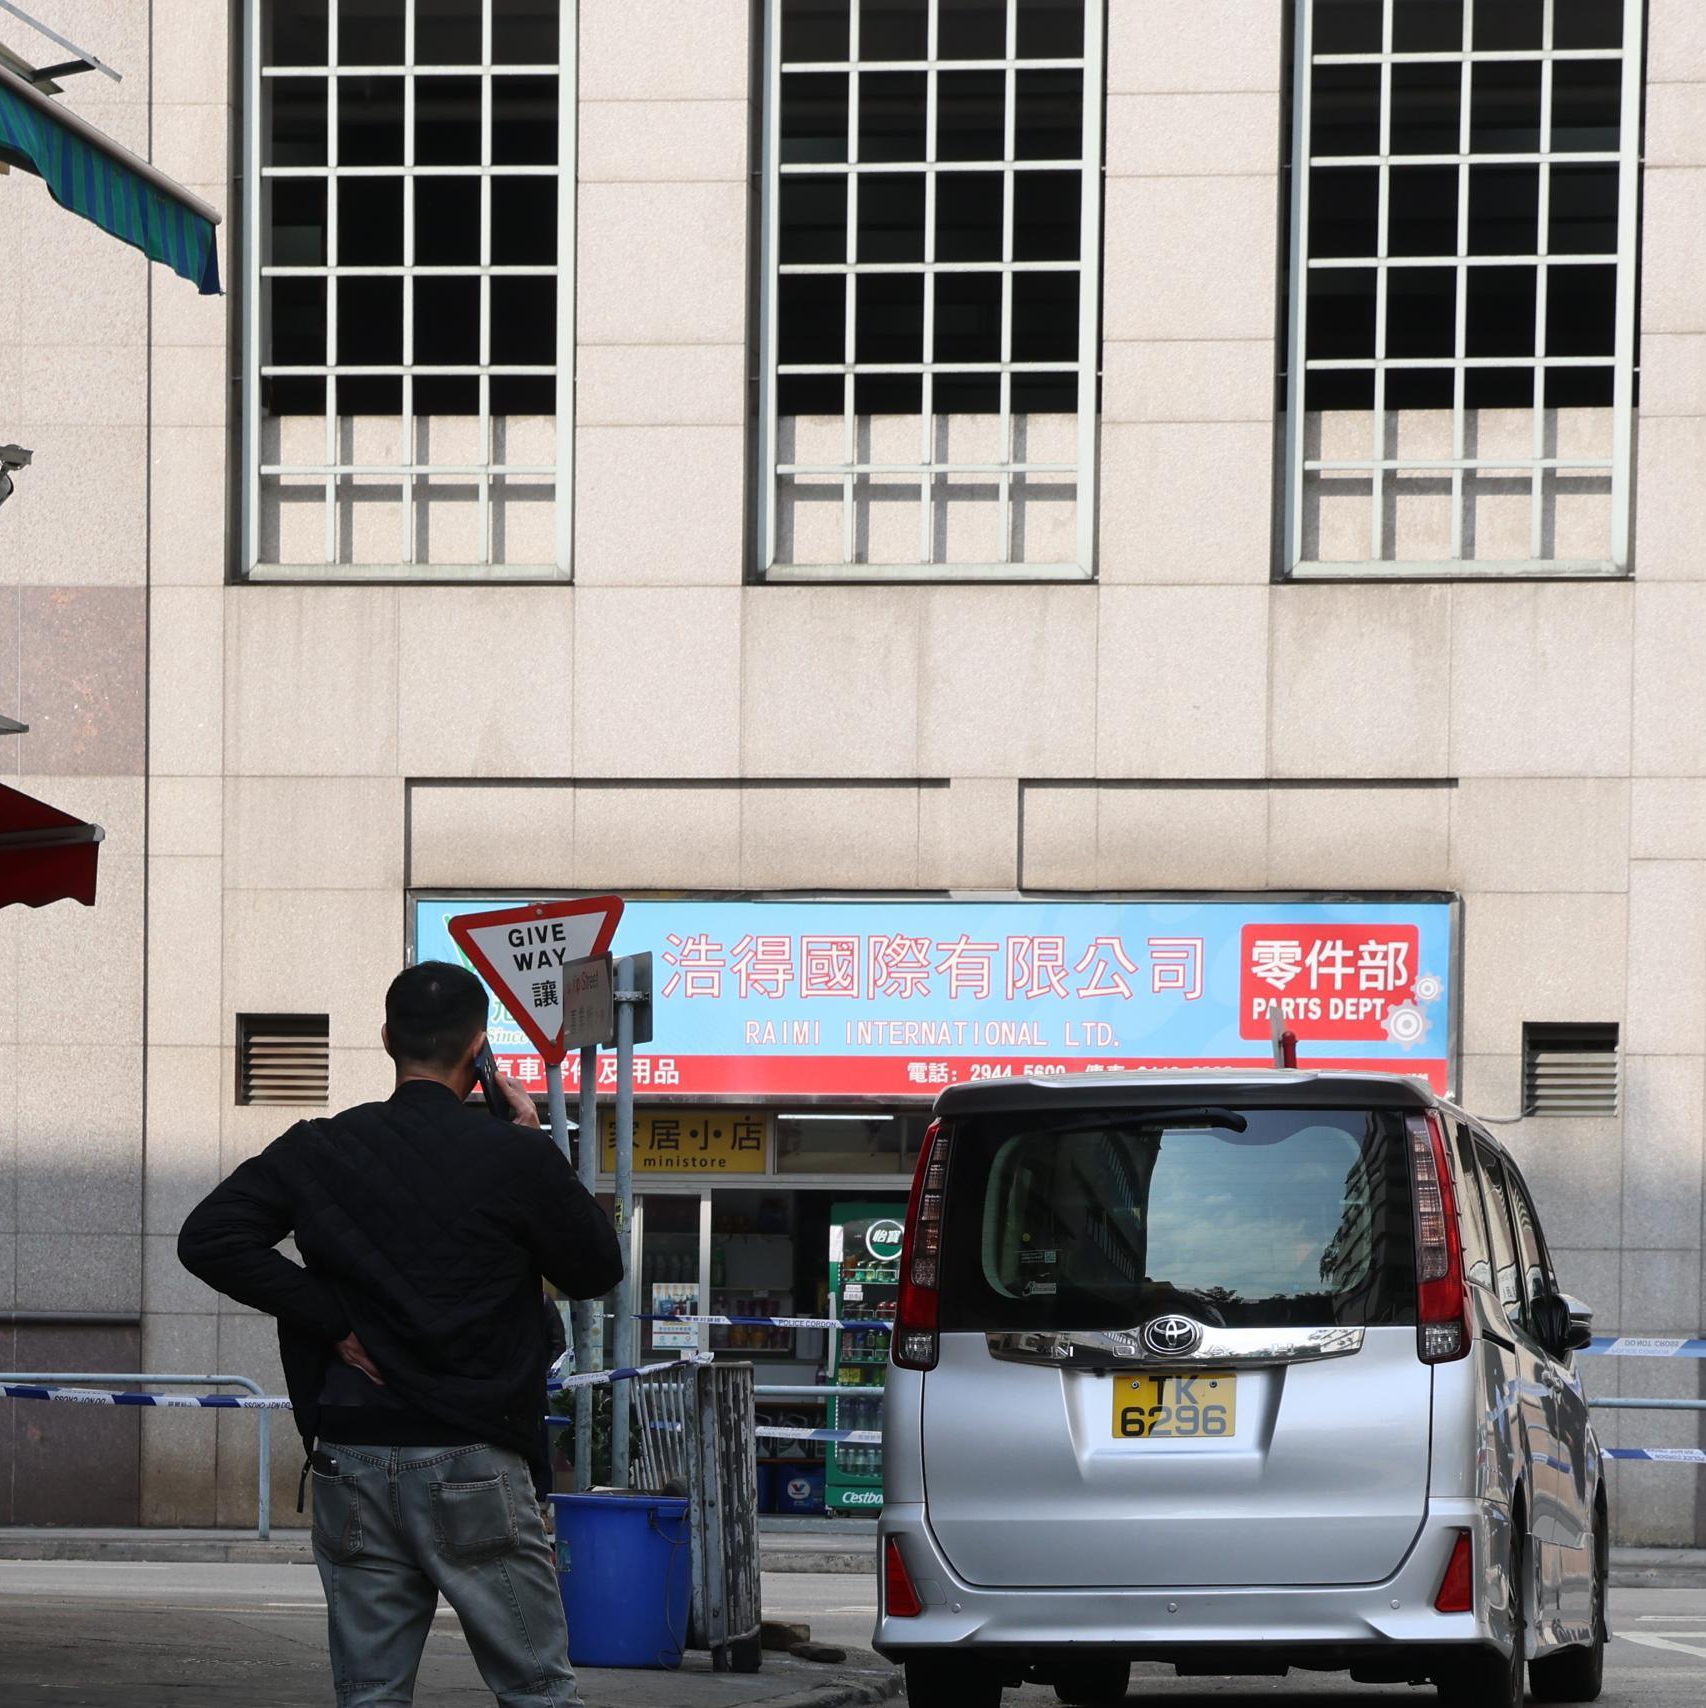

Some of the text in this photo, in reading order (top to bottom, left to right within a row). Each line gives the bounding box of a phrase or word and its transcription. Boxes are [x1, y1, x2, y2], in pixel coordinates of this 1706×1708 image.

[508, 923, 566, 947] GIVE
[513, 948, 566, 971] WAY
[661, 933, 1204, 1000] 浩得國際有限公司
[1251, 939, 1409, 991] 零件部
[532, 980, 559, 1007] 讓
[746, 1020, 1120, 1047] RAIMI INTERNATIONAL LTD.
[970, 1065, 1012, 1081] 2944
[644, 1155, 726, 1169] ministore
[873, 1230, 901, 1243] 怡寶
[1148, 1375, 1199, 1405] TK
[1121, 1405, 1227, 1437] 6296
